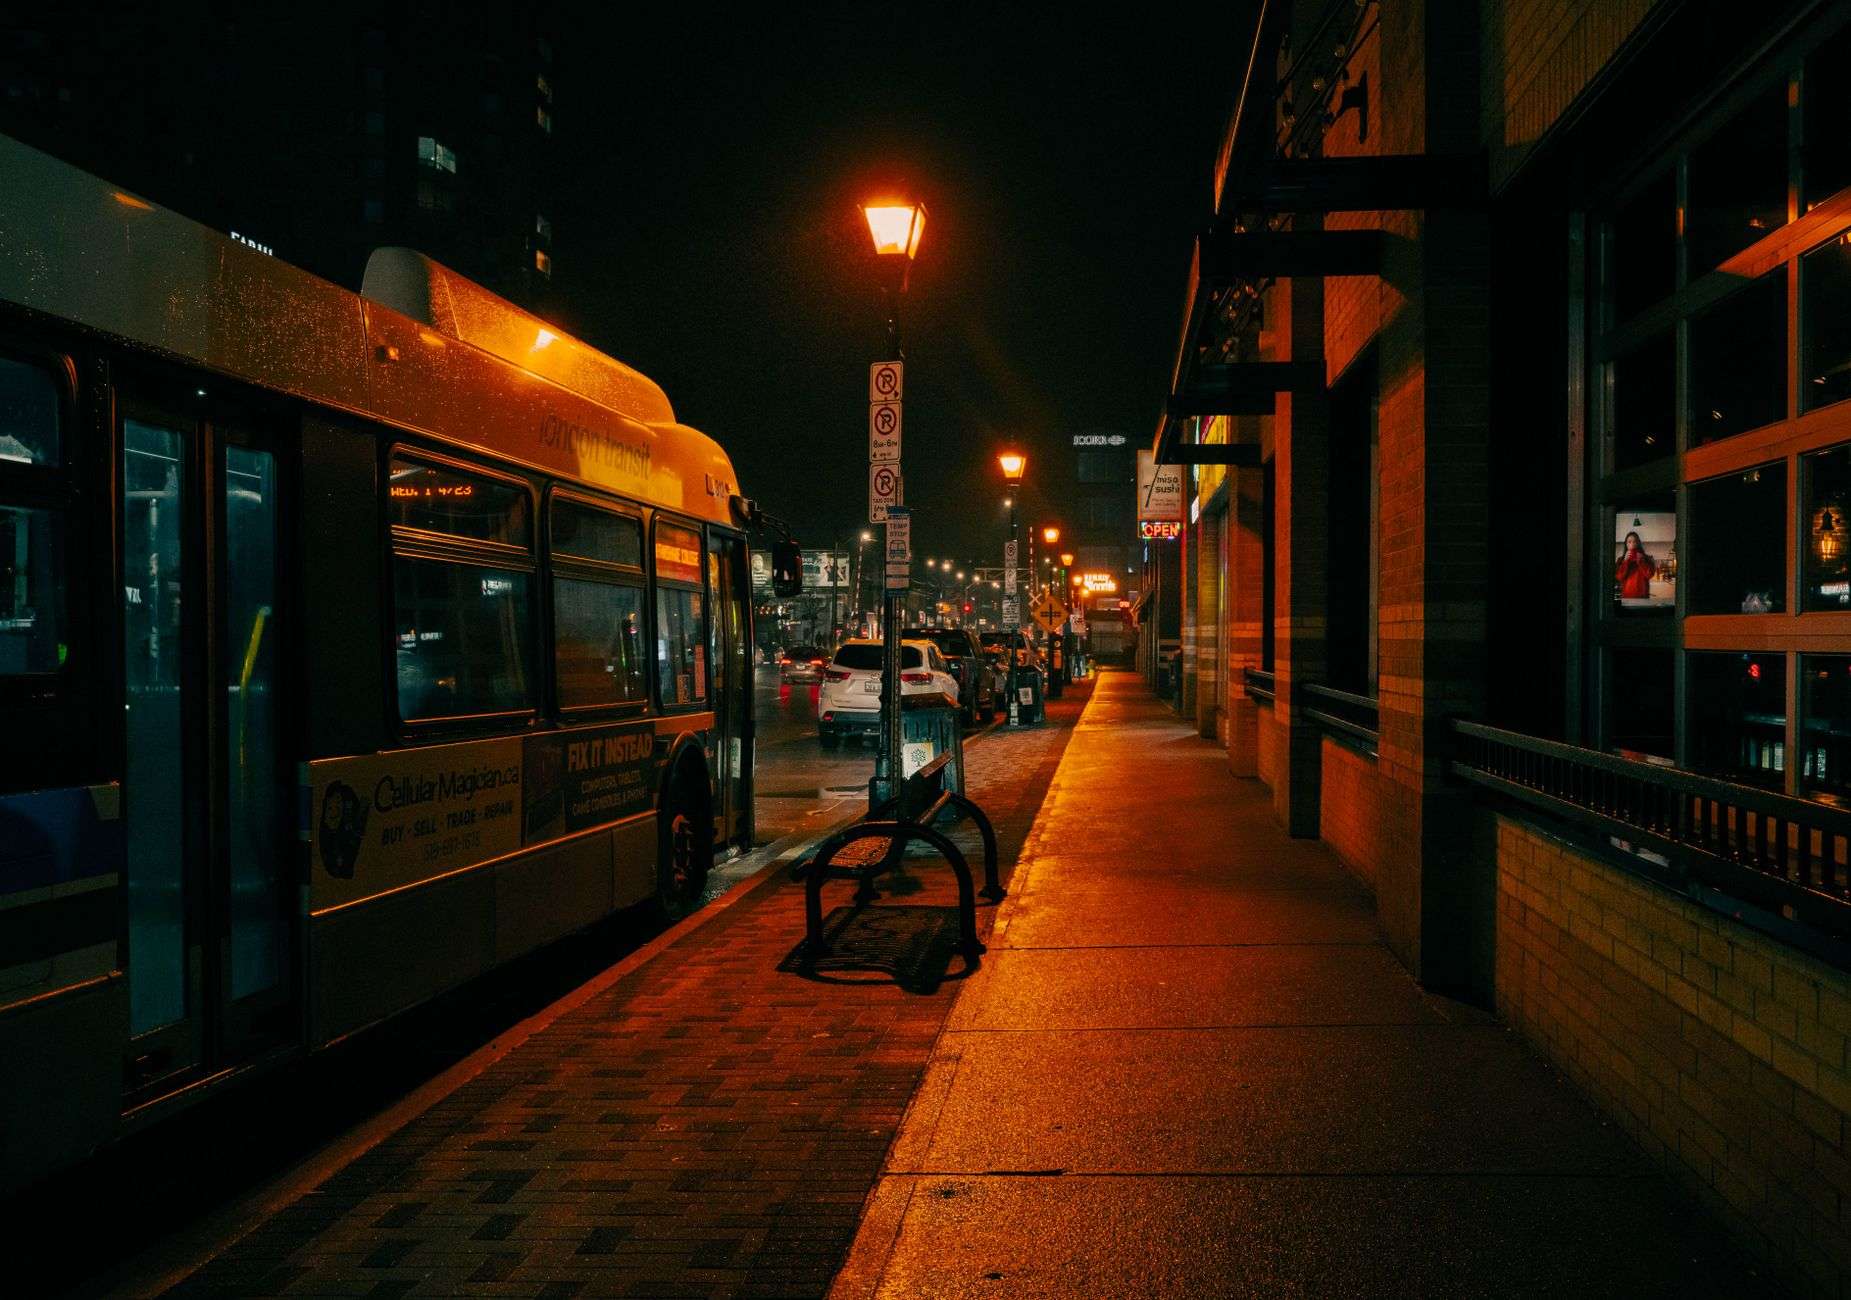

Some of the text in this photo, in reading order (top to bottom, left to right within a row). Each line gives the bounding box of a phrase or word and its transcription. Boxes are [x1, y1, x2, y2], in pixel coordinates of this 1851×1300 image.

[1157, 473, 1179, 484] miso
[1155, 483, 1181, 493] sushi
[1144, 524, 1179, 537] OPEN
[567, 741, 589, 772] FIX
[592, 738, 604, 768] IT
[605, 733, 654, 765] INSTEAD
